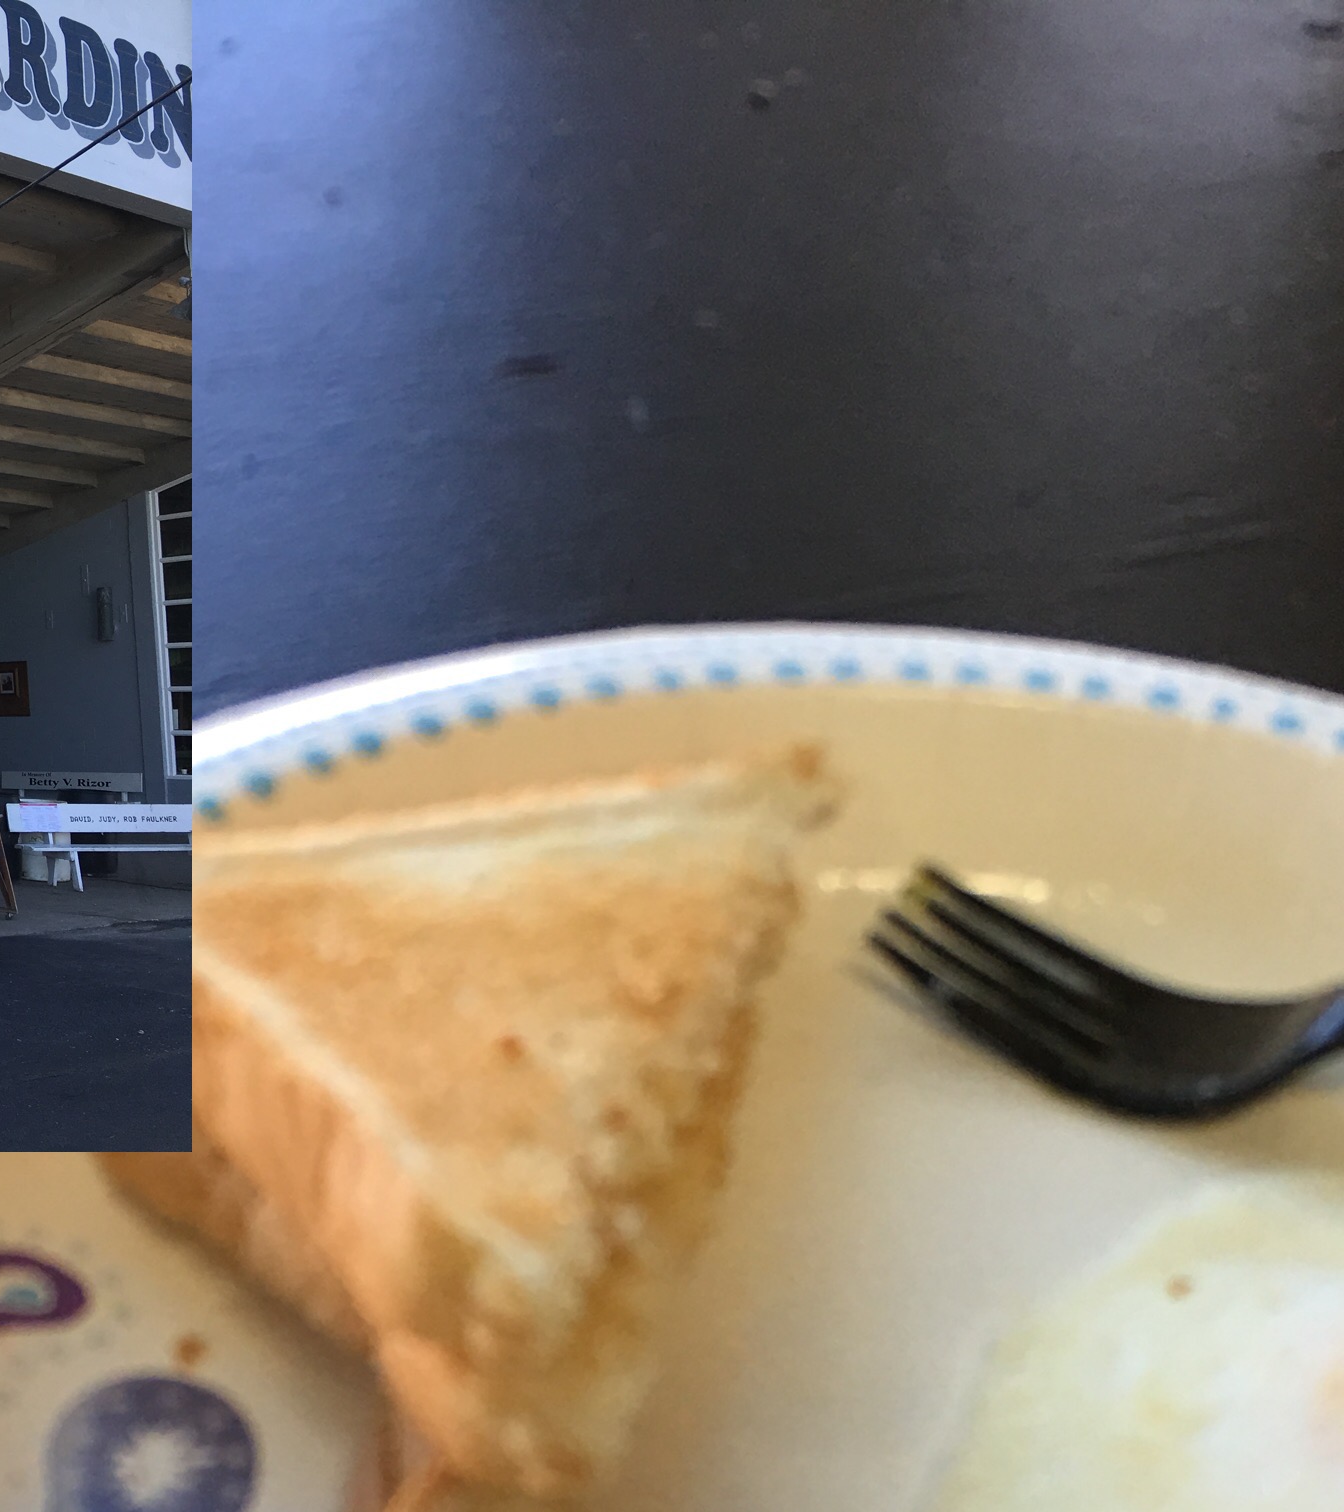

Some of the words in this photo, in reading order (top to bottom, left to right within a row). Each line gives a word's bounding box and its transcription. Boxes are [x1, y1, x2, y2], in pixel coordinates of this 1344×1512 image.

[29, 777, 59, 788] Betty
[62, 778, 73, 787] V.
[77, 778, 111, 787] Rizor
